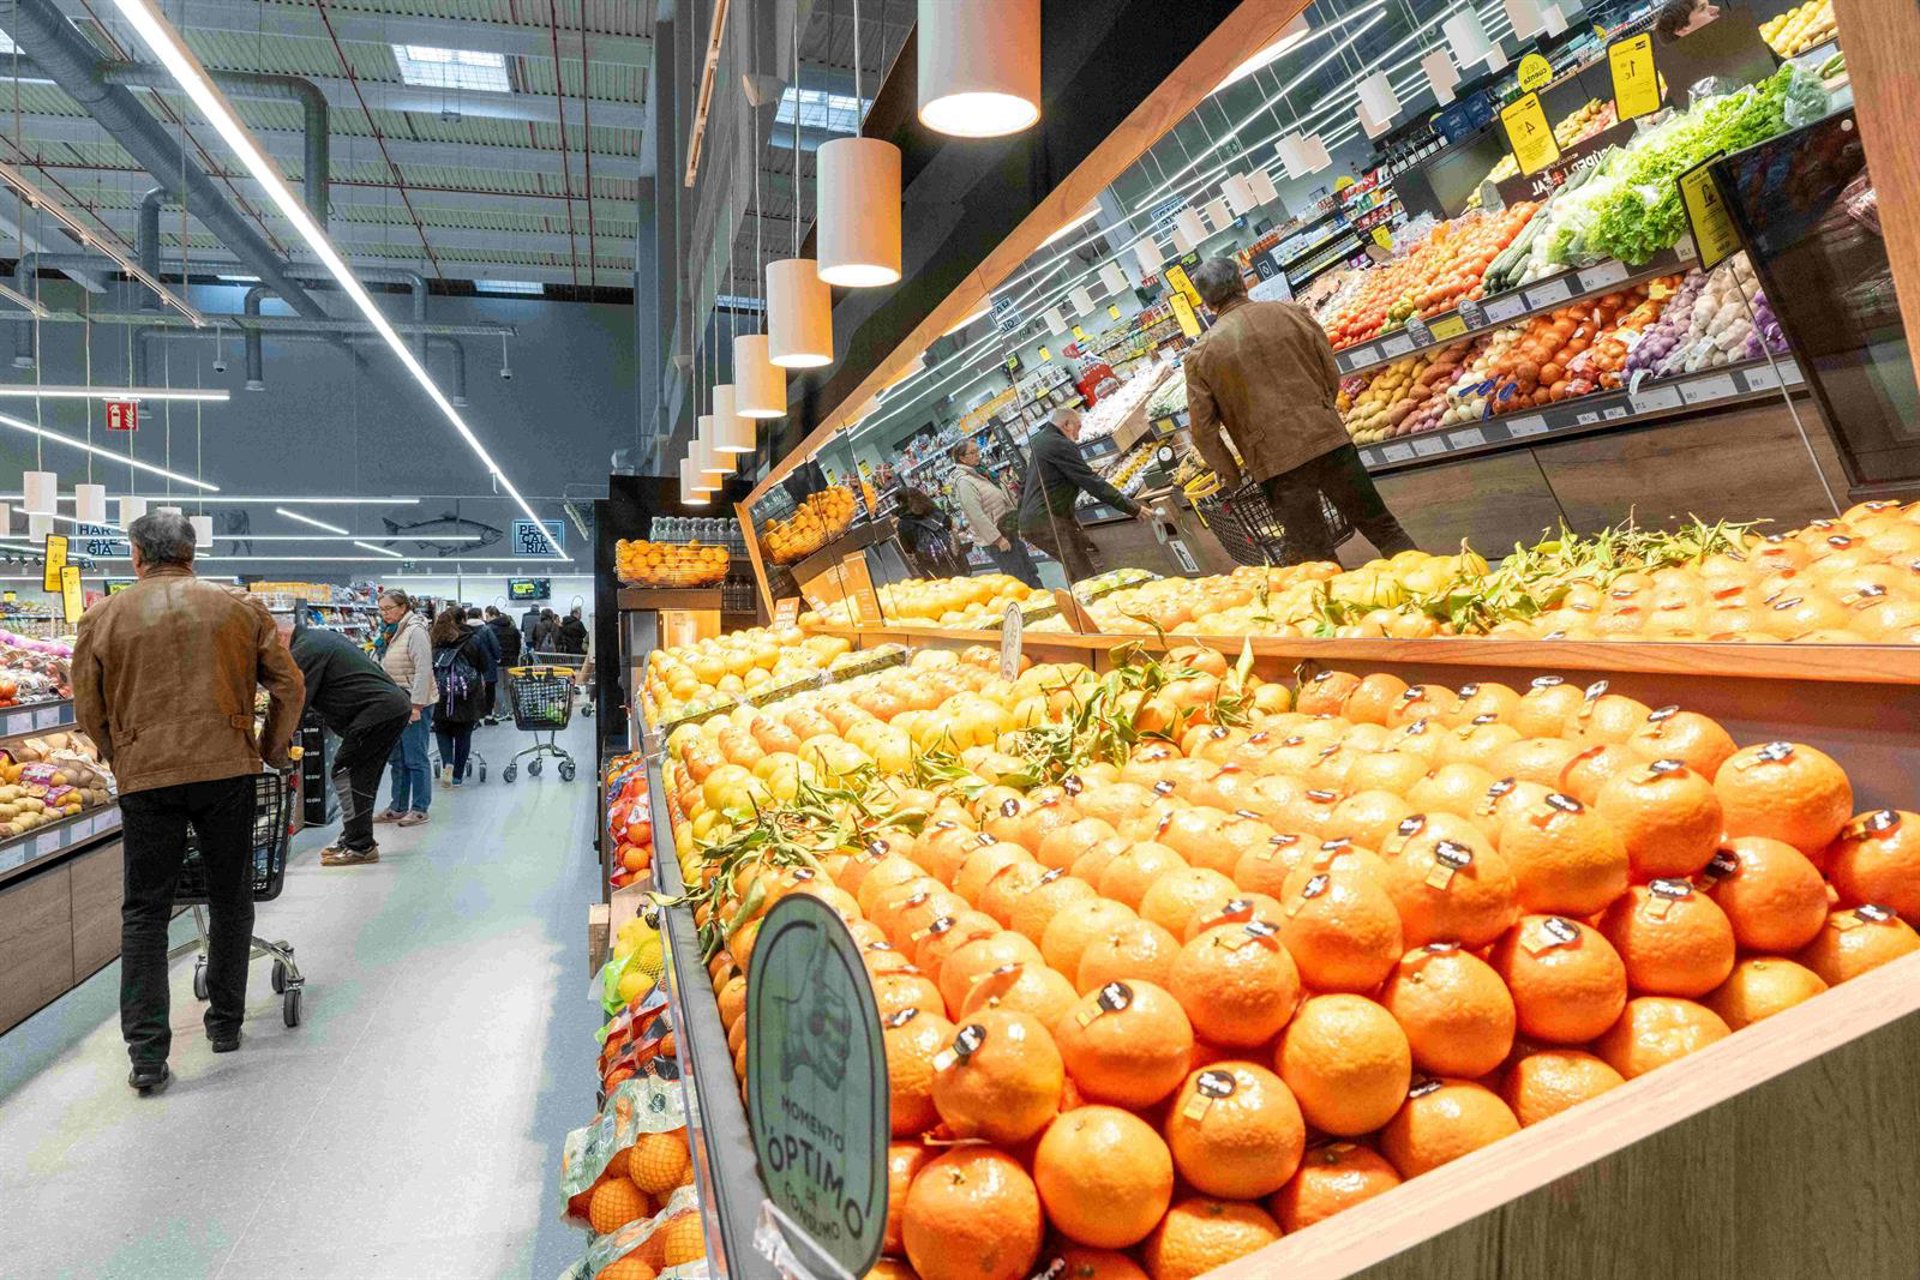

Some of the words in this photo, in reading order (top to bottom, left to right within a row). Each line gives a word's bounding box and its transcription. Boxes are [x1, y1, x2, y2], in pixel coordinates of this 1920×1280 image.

[526, 542, 548, 553] RIA
[781, 1095, 844, 1153] MOMENTO
[768, 1126, 863, 1241] ÓPTIMO
[784, 1181, 840, 1240] CONSUMO
